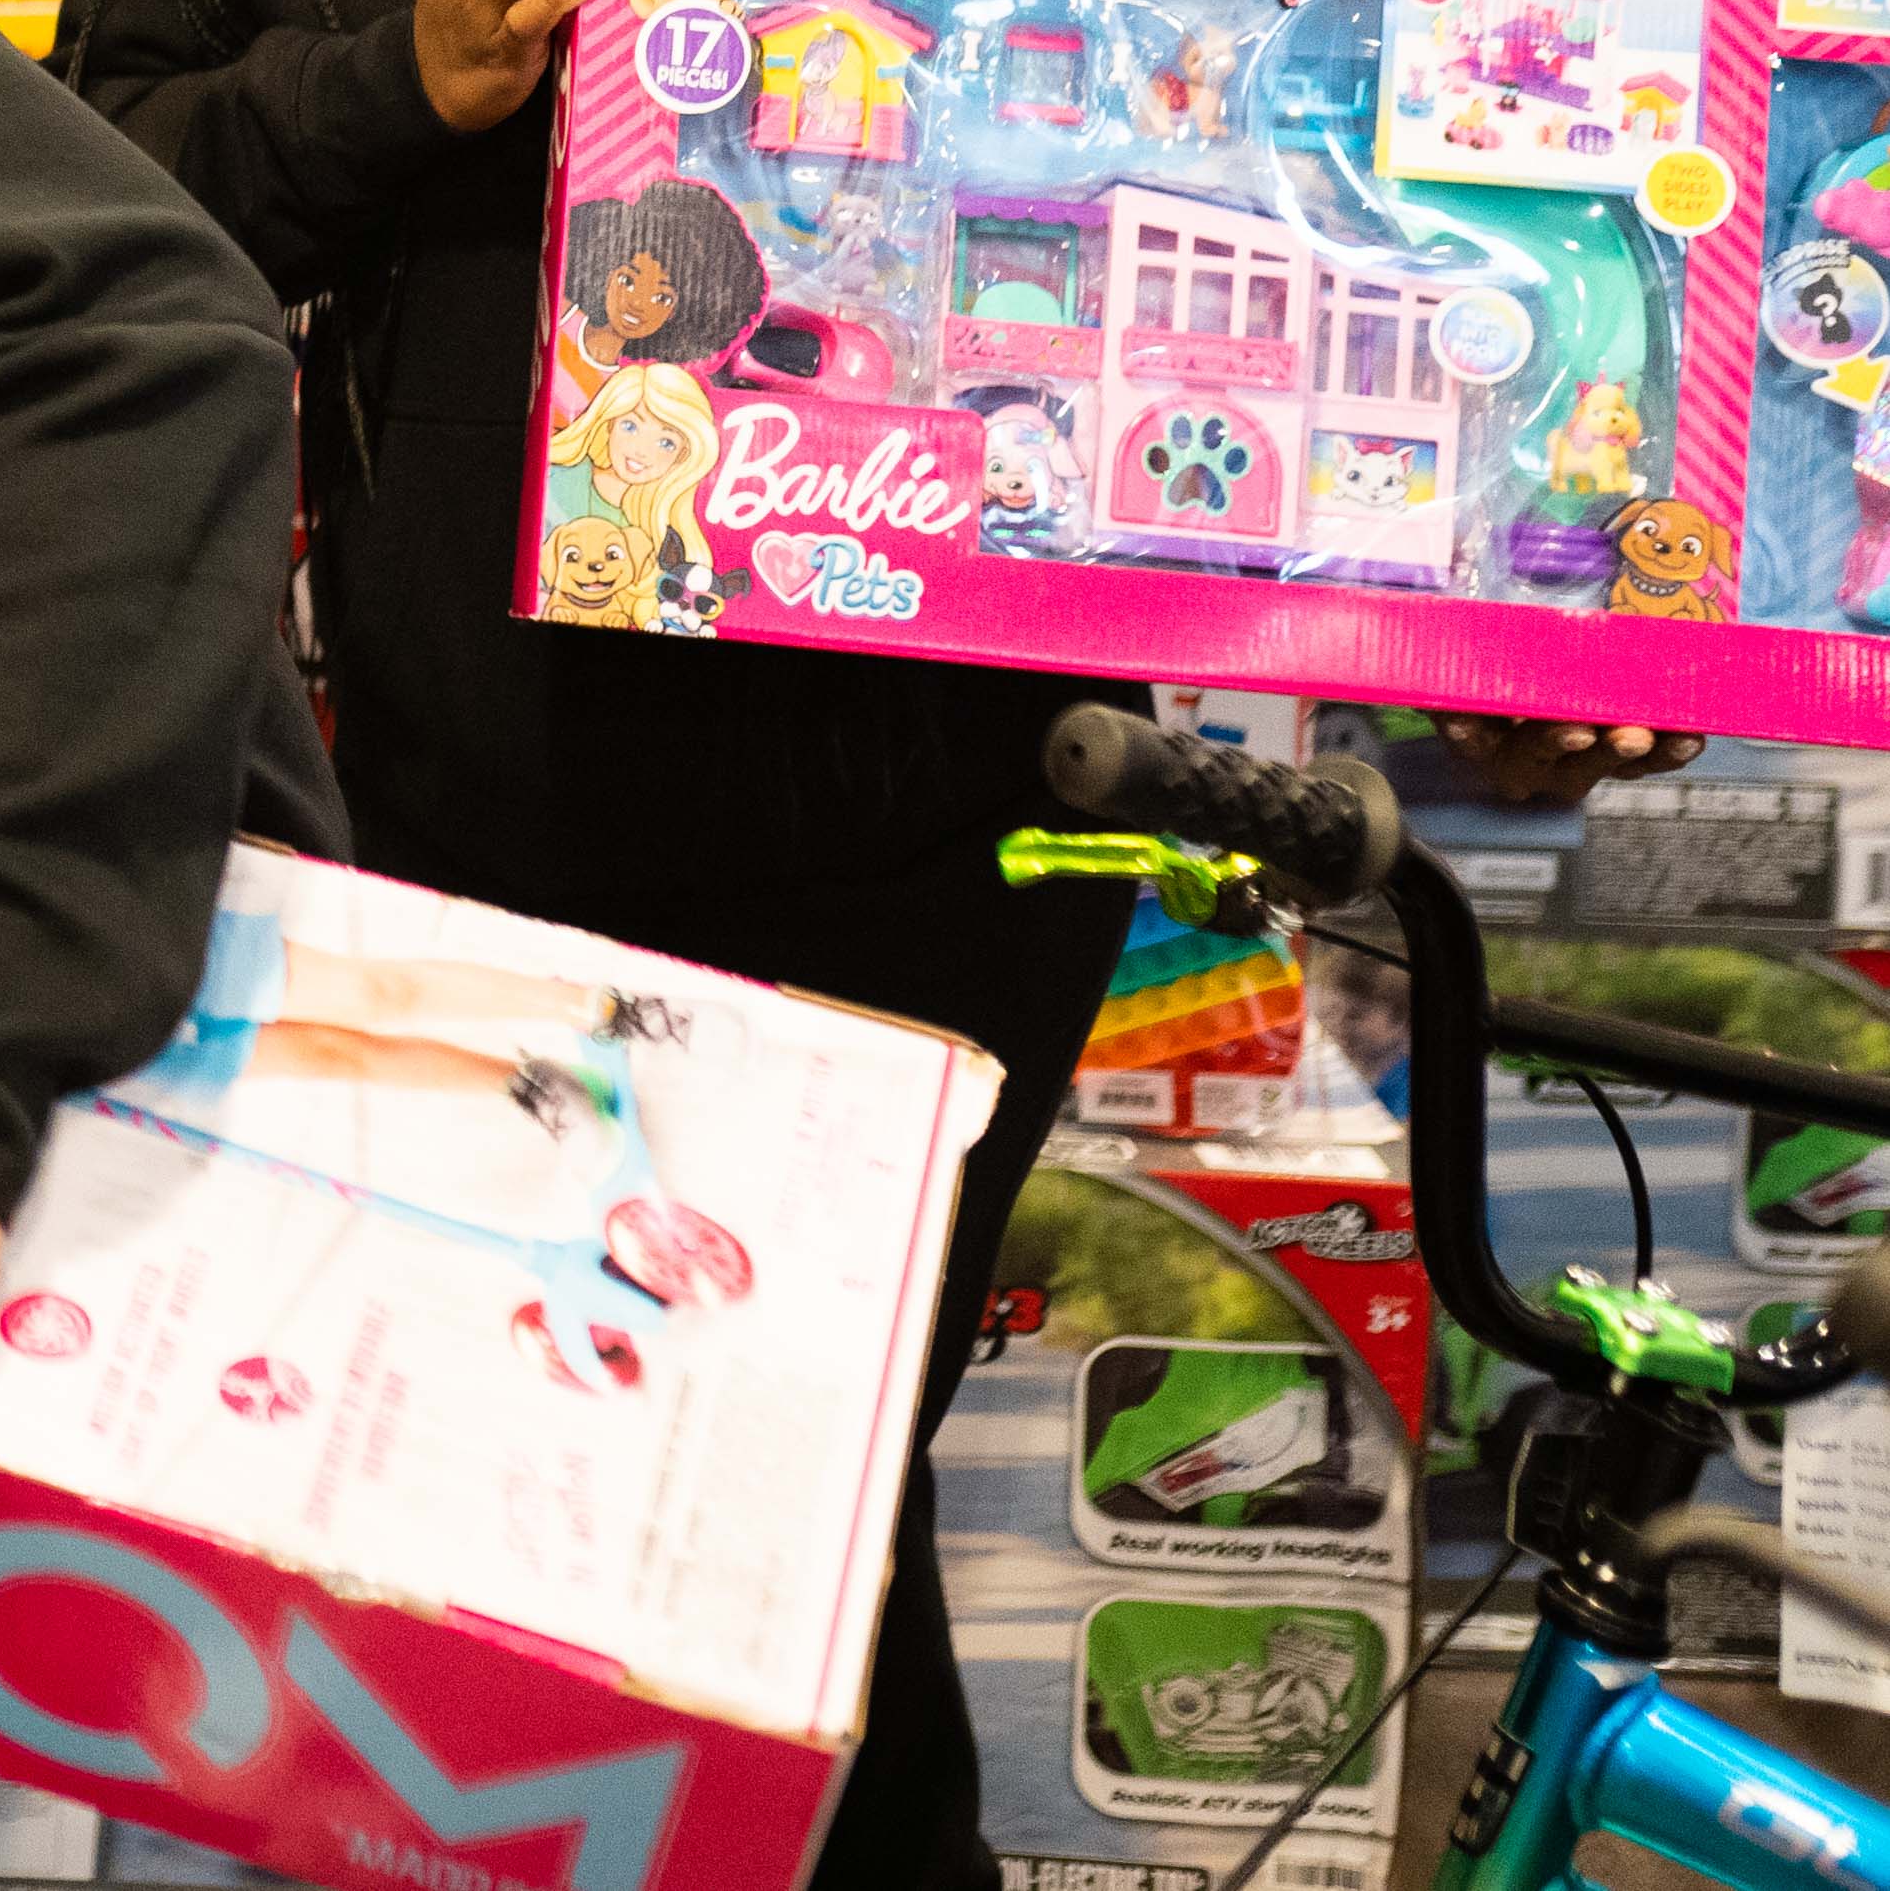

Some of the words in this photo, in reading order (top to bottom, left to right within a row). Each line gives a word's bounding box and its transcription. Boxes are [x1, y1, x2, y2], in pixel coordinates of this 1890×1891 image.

[665, 16, 729, 68] 17
[657, 65, 728, 91] PIECES!
[706, 402, 970, 536] Barbie
[808, 535, 924, 620] Pets
[1168, 1537, 1266, 1563] working
